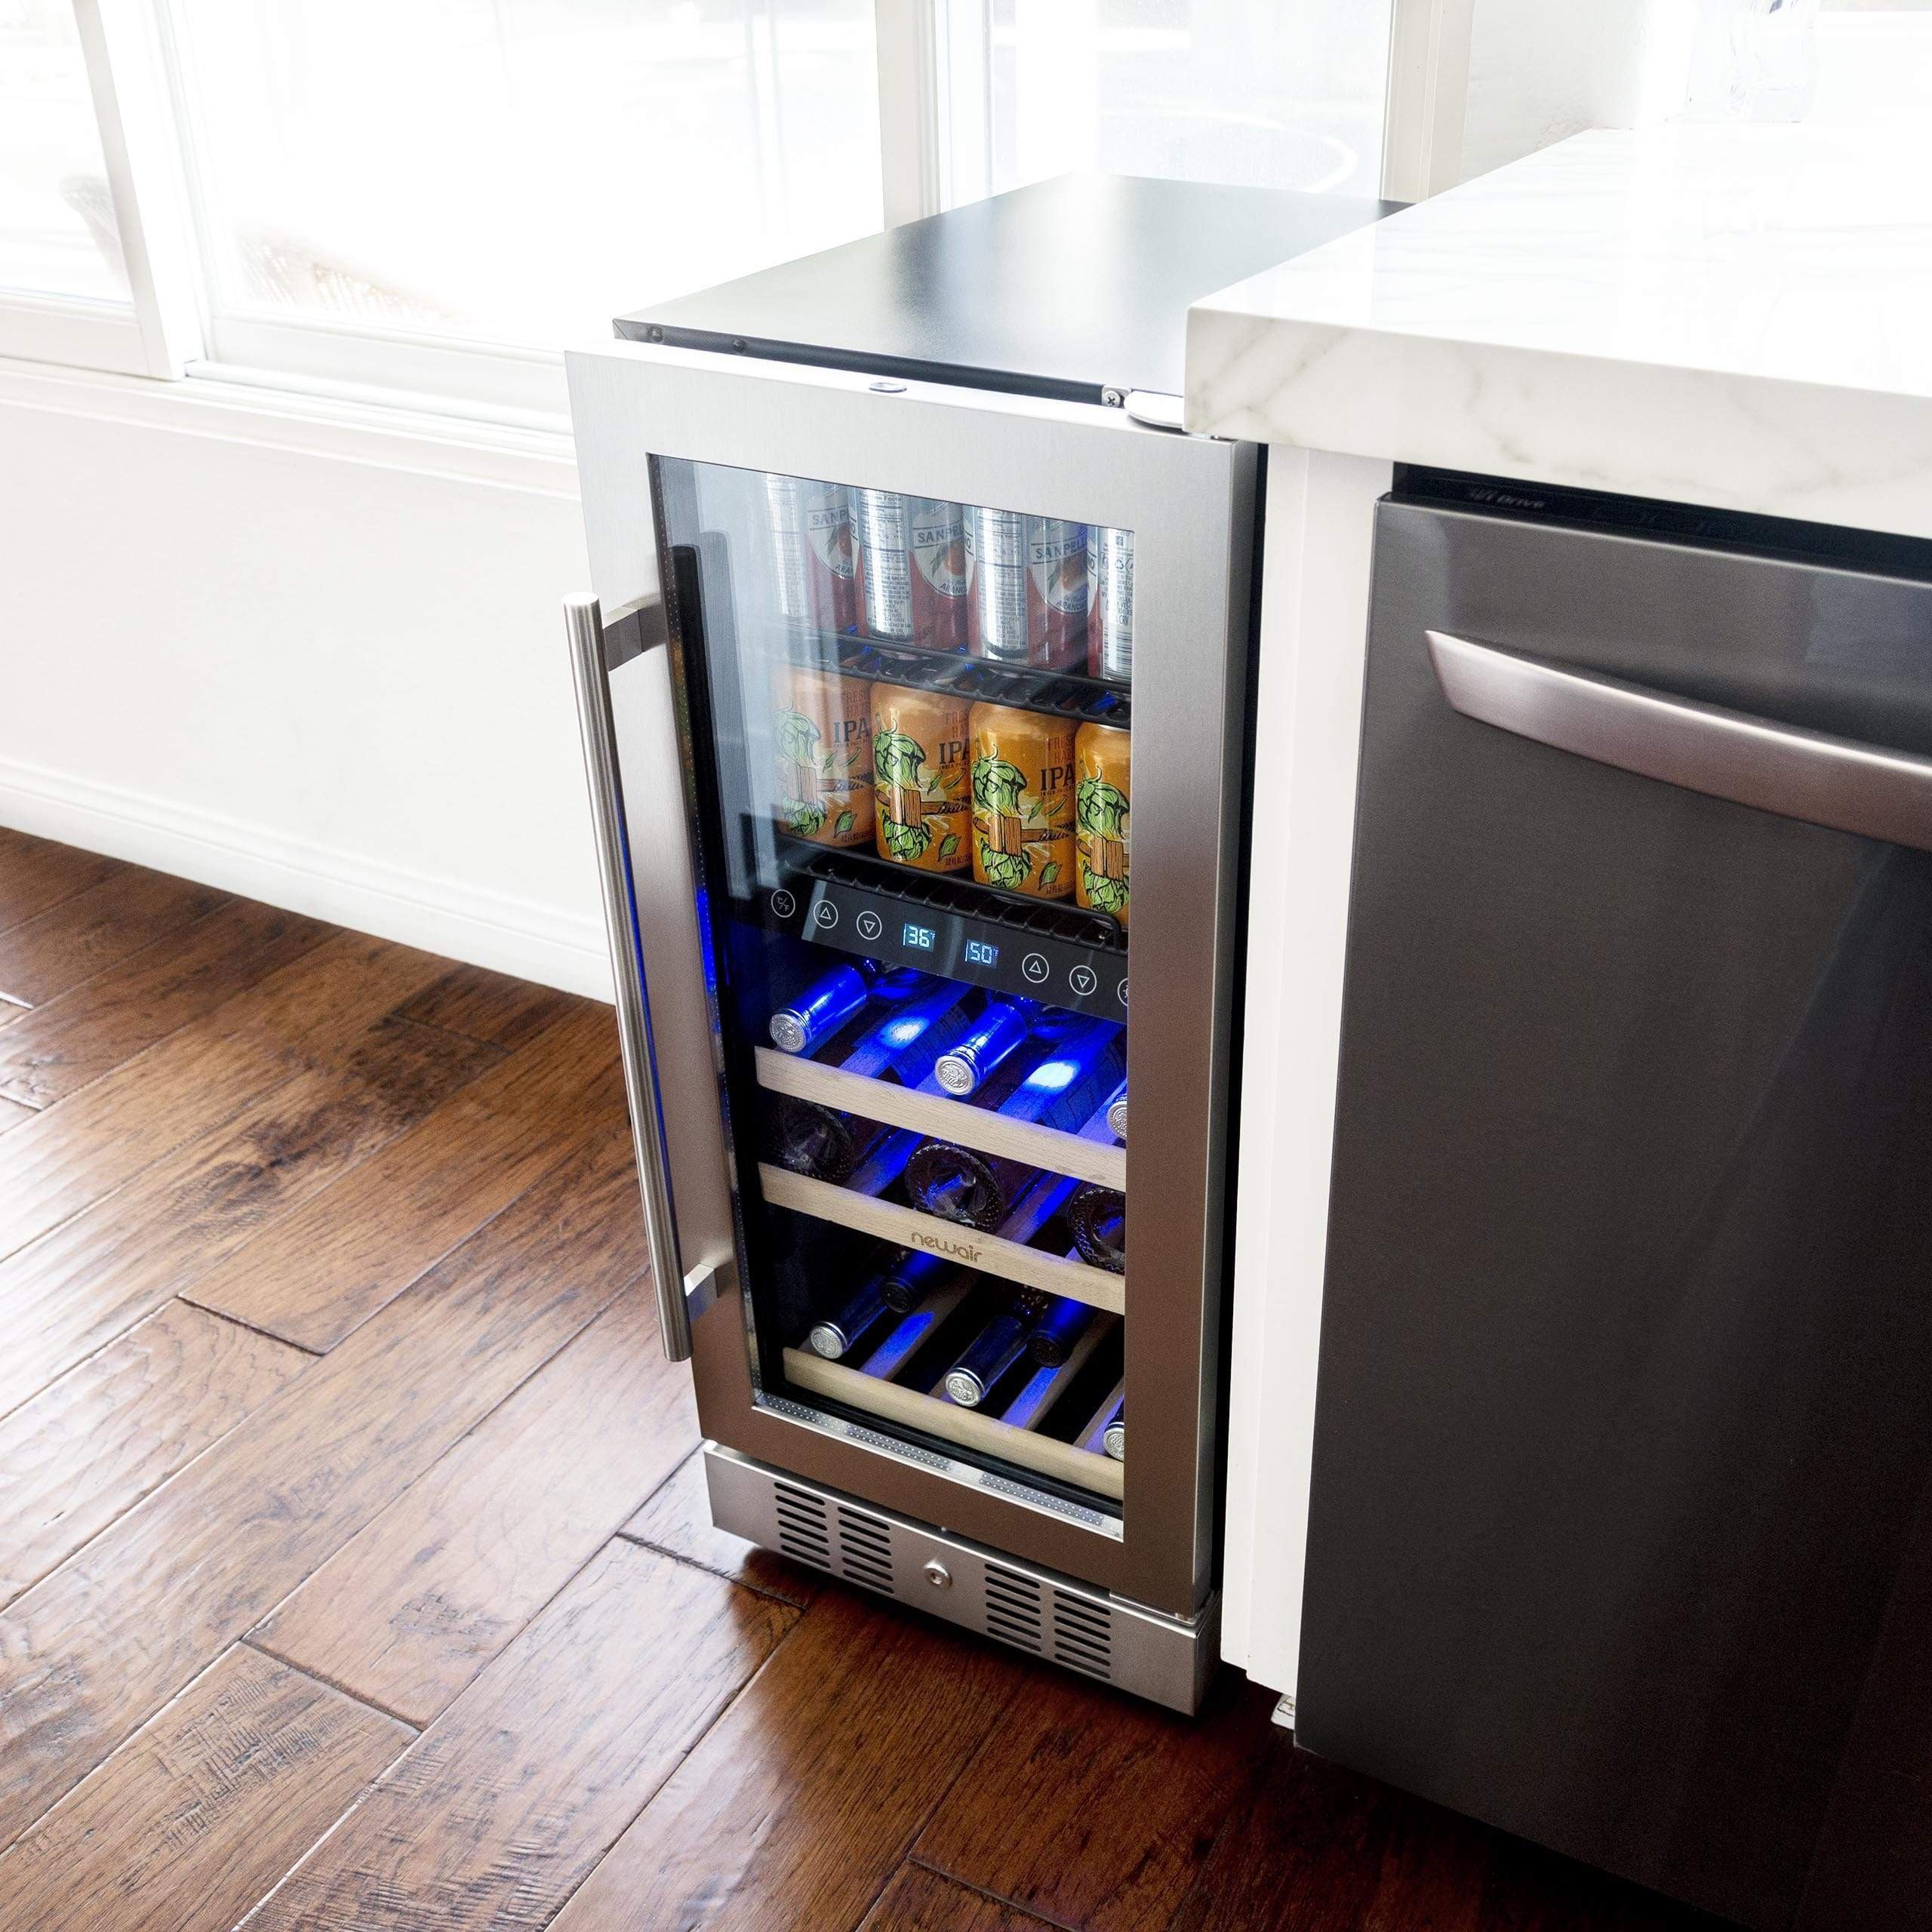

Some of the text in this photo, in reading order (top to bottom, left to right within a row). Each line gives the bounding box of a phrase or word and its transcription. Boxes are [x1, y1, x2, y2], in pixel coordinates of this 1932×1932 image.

[834, 718, 870, 743] IPA
[1041, 763, 1075, 792] IPA
[911, 1231, 983, 1263] newair
